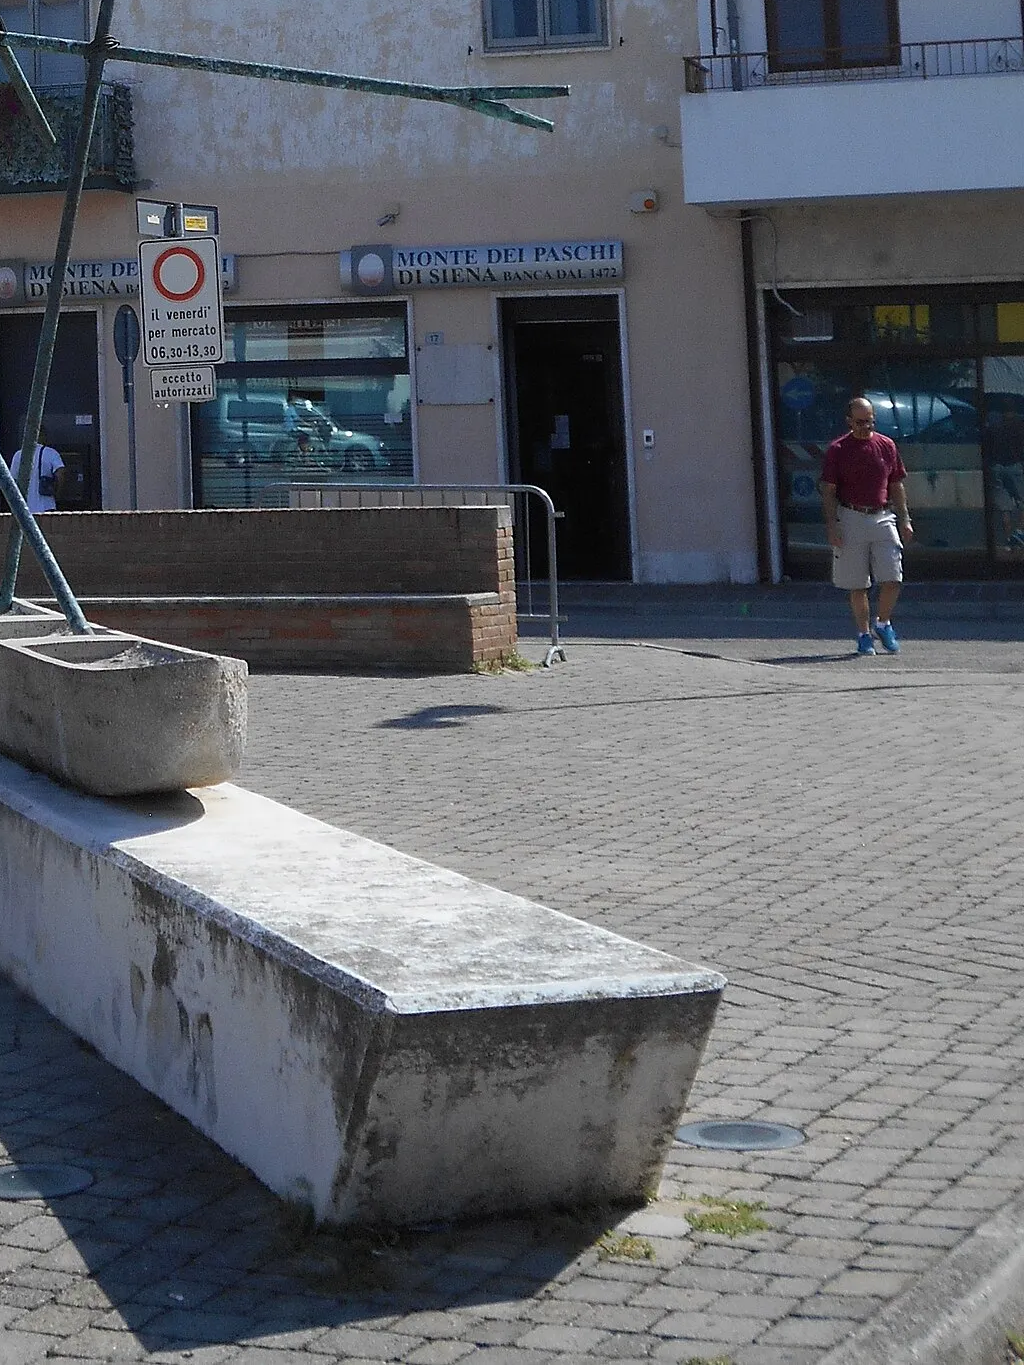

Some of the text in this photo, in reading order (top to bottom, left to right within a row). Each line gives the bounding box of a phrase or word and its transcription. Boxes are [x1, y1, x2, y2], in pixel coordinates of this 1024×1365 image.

[398, 244, 616, 267] MONTE DEI PASCHI
[112, 261, 139, 276] DE
[399, 267, 617, 285] DI SIENA BANCA DAL 1472
[151, 308, 160, 321] il
[148, 324, 217, 341] per mercato
[162, 371, 202, 384] eccetto
[154, 383, 212, 398] autorizzati
